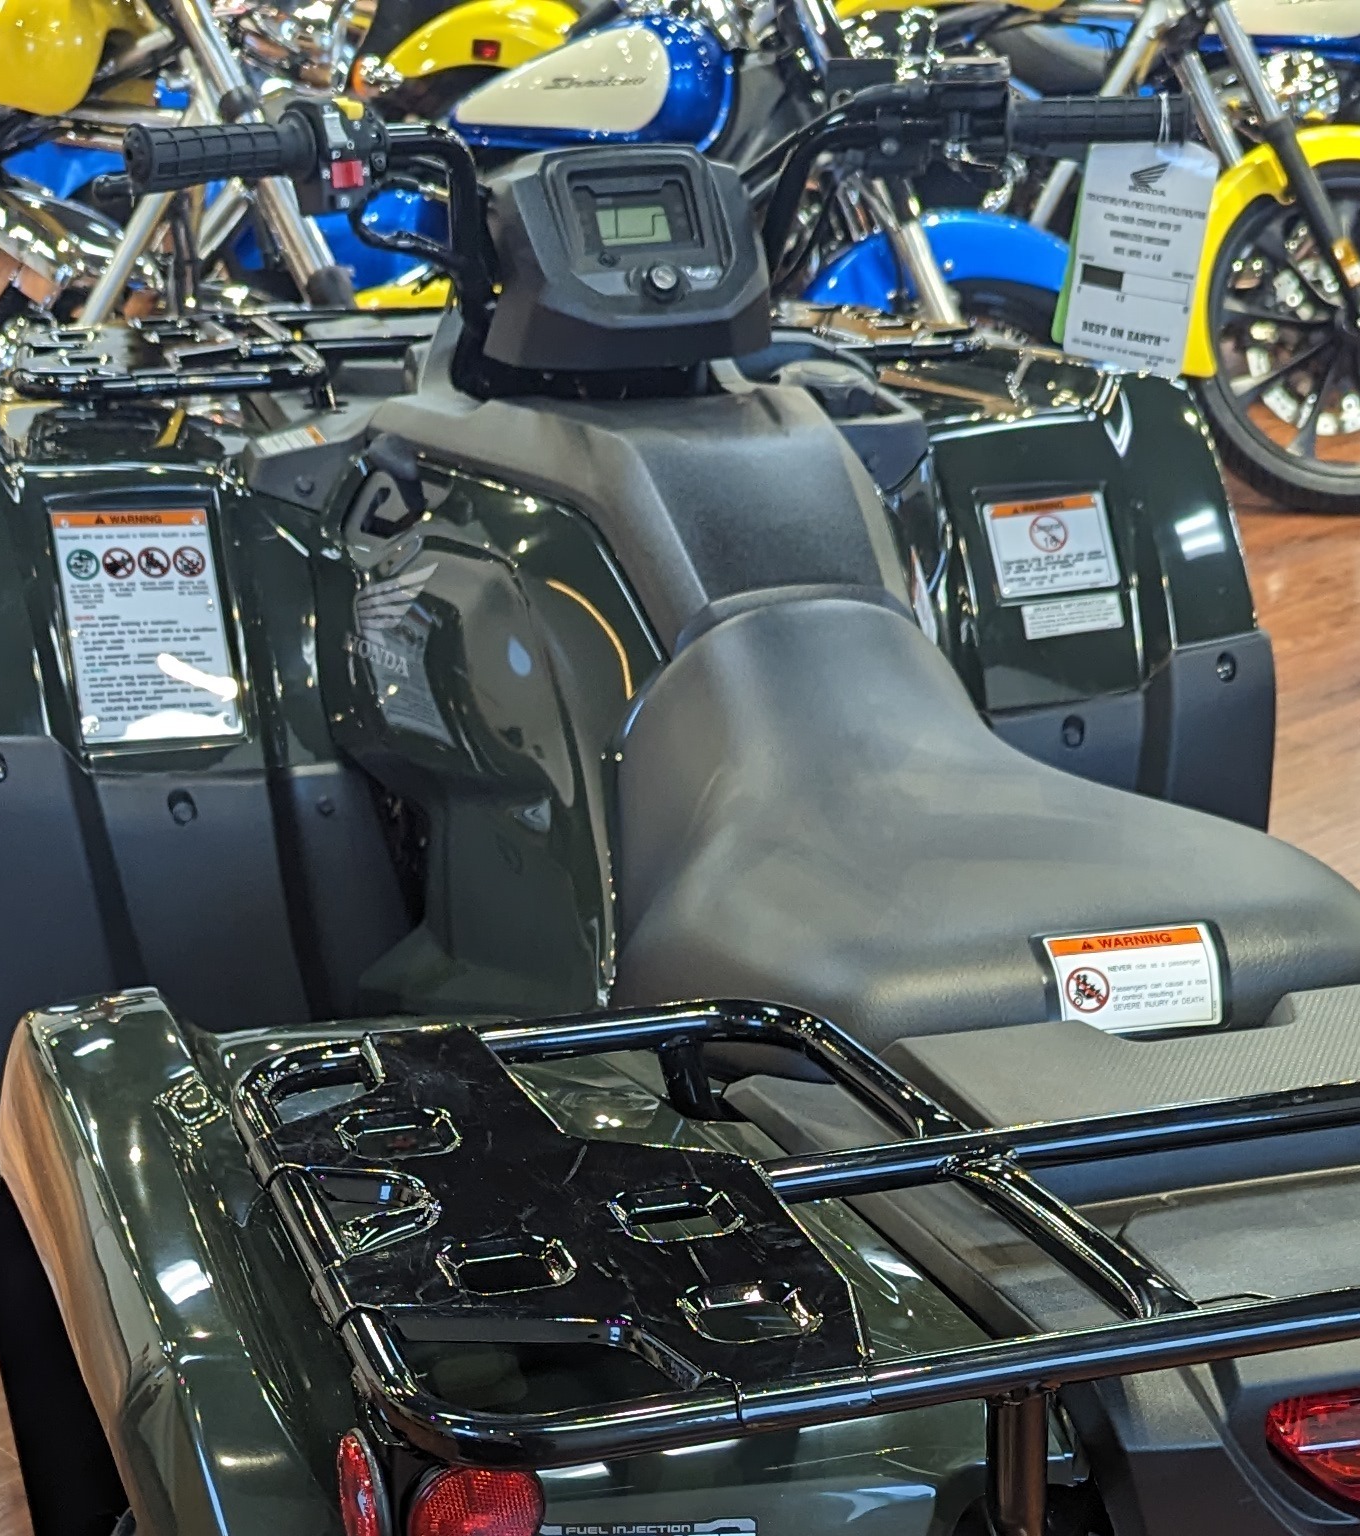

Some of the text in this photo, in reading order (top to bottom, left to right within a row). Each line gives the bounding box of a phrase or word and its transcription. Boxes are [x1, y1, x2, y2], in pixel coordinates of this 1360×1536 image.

[1082, 320, 1108, 336] BEST
[1110, 327, 1124, 340] ON
[110, 514, 163, 524] WARNING
[1097, 933, 1172, 949] WARNING
[1107, 964, 1132, 973] NEVER
[1111, 982, 1147, 992] Passengers
[1164, 980, 1184, 988] cause
[1113, 1001, 1141, 1012] SEVERE
[1144, 999, 1169, 1008] INJURY
[565, 1524, 691, 1535] FUEL INJECTION
